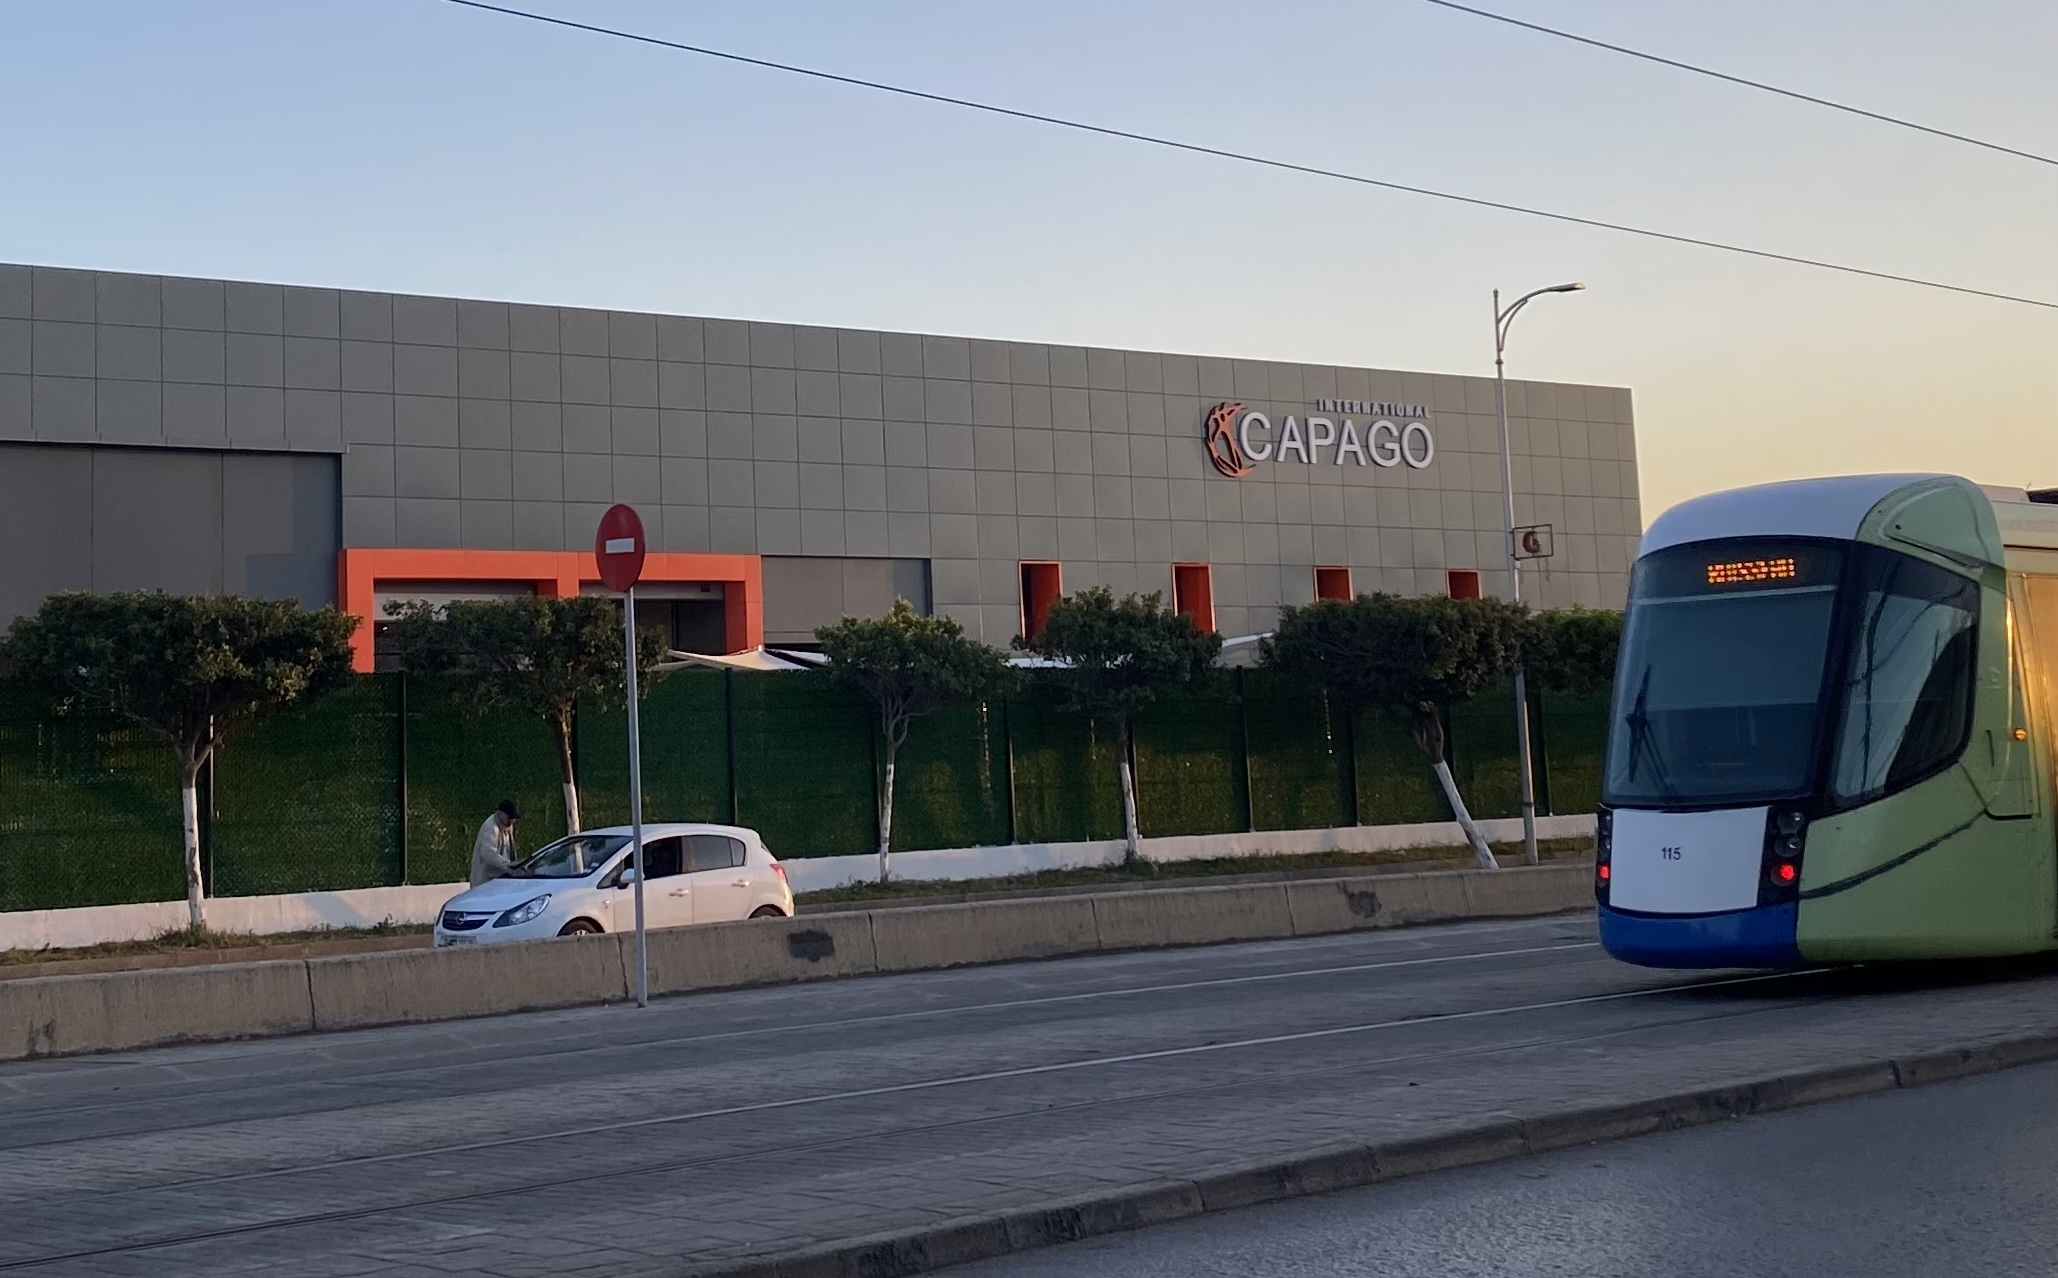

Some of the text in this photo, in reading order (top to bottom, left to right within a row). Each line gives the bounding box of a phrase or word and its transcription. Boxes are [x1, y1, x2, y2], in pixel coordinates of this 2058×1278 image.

[1317, 398, 1431, 418] INTERNATIONAL
[1239, 411, 1434, 469] CAPAGO
[1661, 846, 1682, 861] 115
